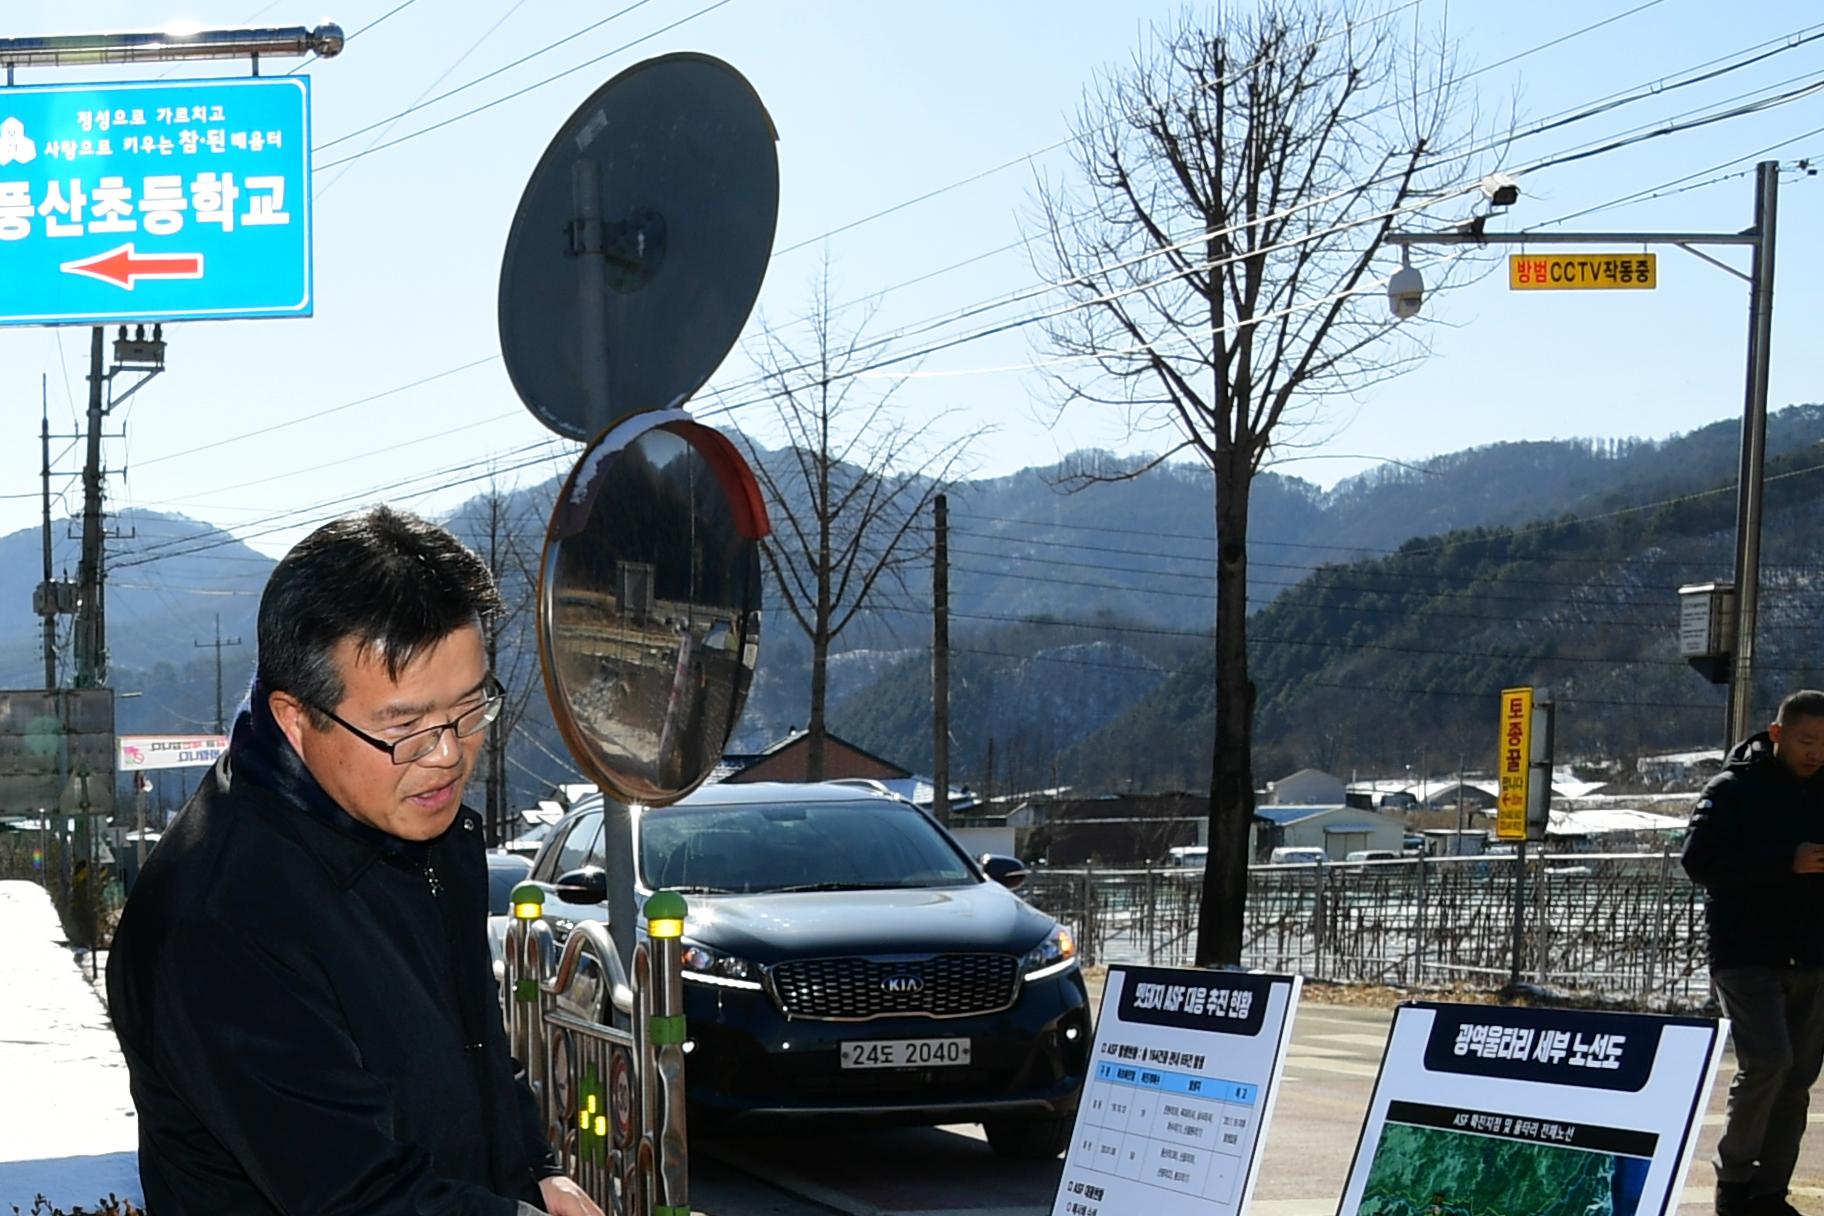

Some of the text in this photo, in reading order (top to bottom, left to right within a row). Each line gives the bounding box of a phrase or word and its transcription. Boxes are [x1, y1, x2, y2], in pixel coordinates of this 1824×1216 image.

[77, 105, 225, 131] 정성으로 가르치고
[44, 139, 113, 160] 사랑으로
[123, 135, 174, 155] 키우는
[230, 130, 282, 151] 배움터
[1506, 697, 1524, 773] 토종꿀
[889, 979, 918, 992] KIA
[1163, 985, 1186, 1012] ASF
[1183, 986, 1207, 1015] 대응
[1206, 988, 1230, 1017] 추진
[1228, 989, 1253, 1019] 현황
[853, 1042, 959, 1065] 24도 2040
[1454, 1024, 1627, 1070] 광역울타리 세부 노선도
[1453, 1113, 1469, 1127] ASF
